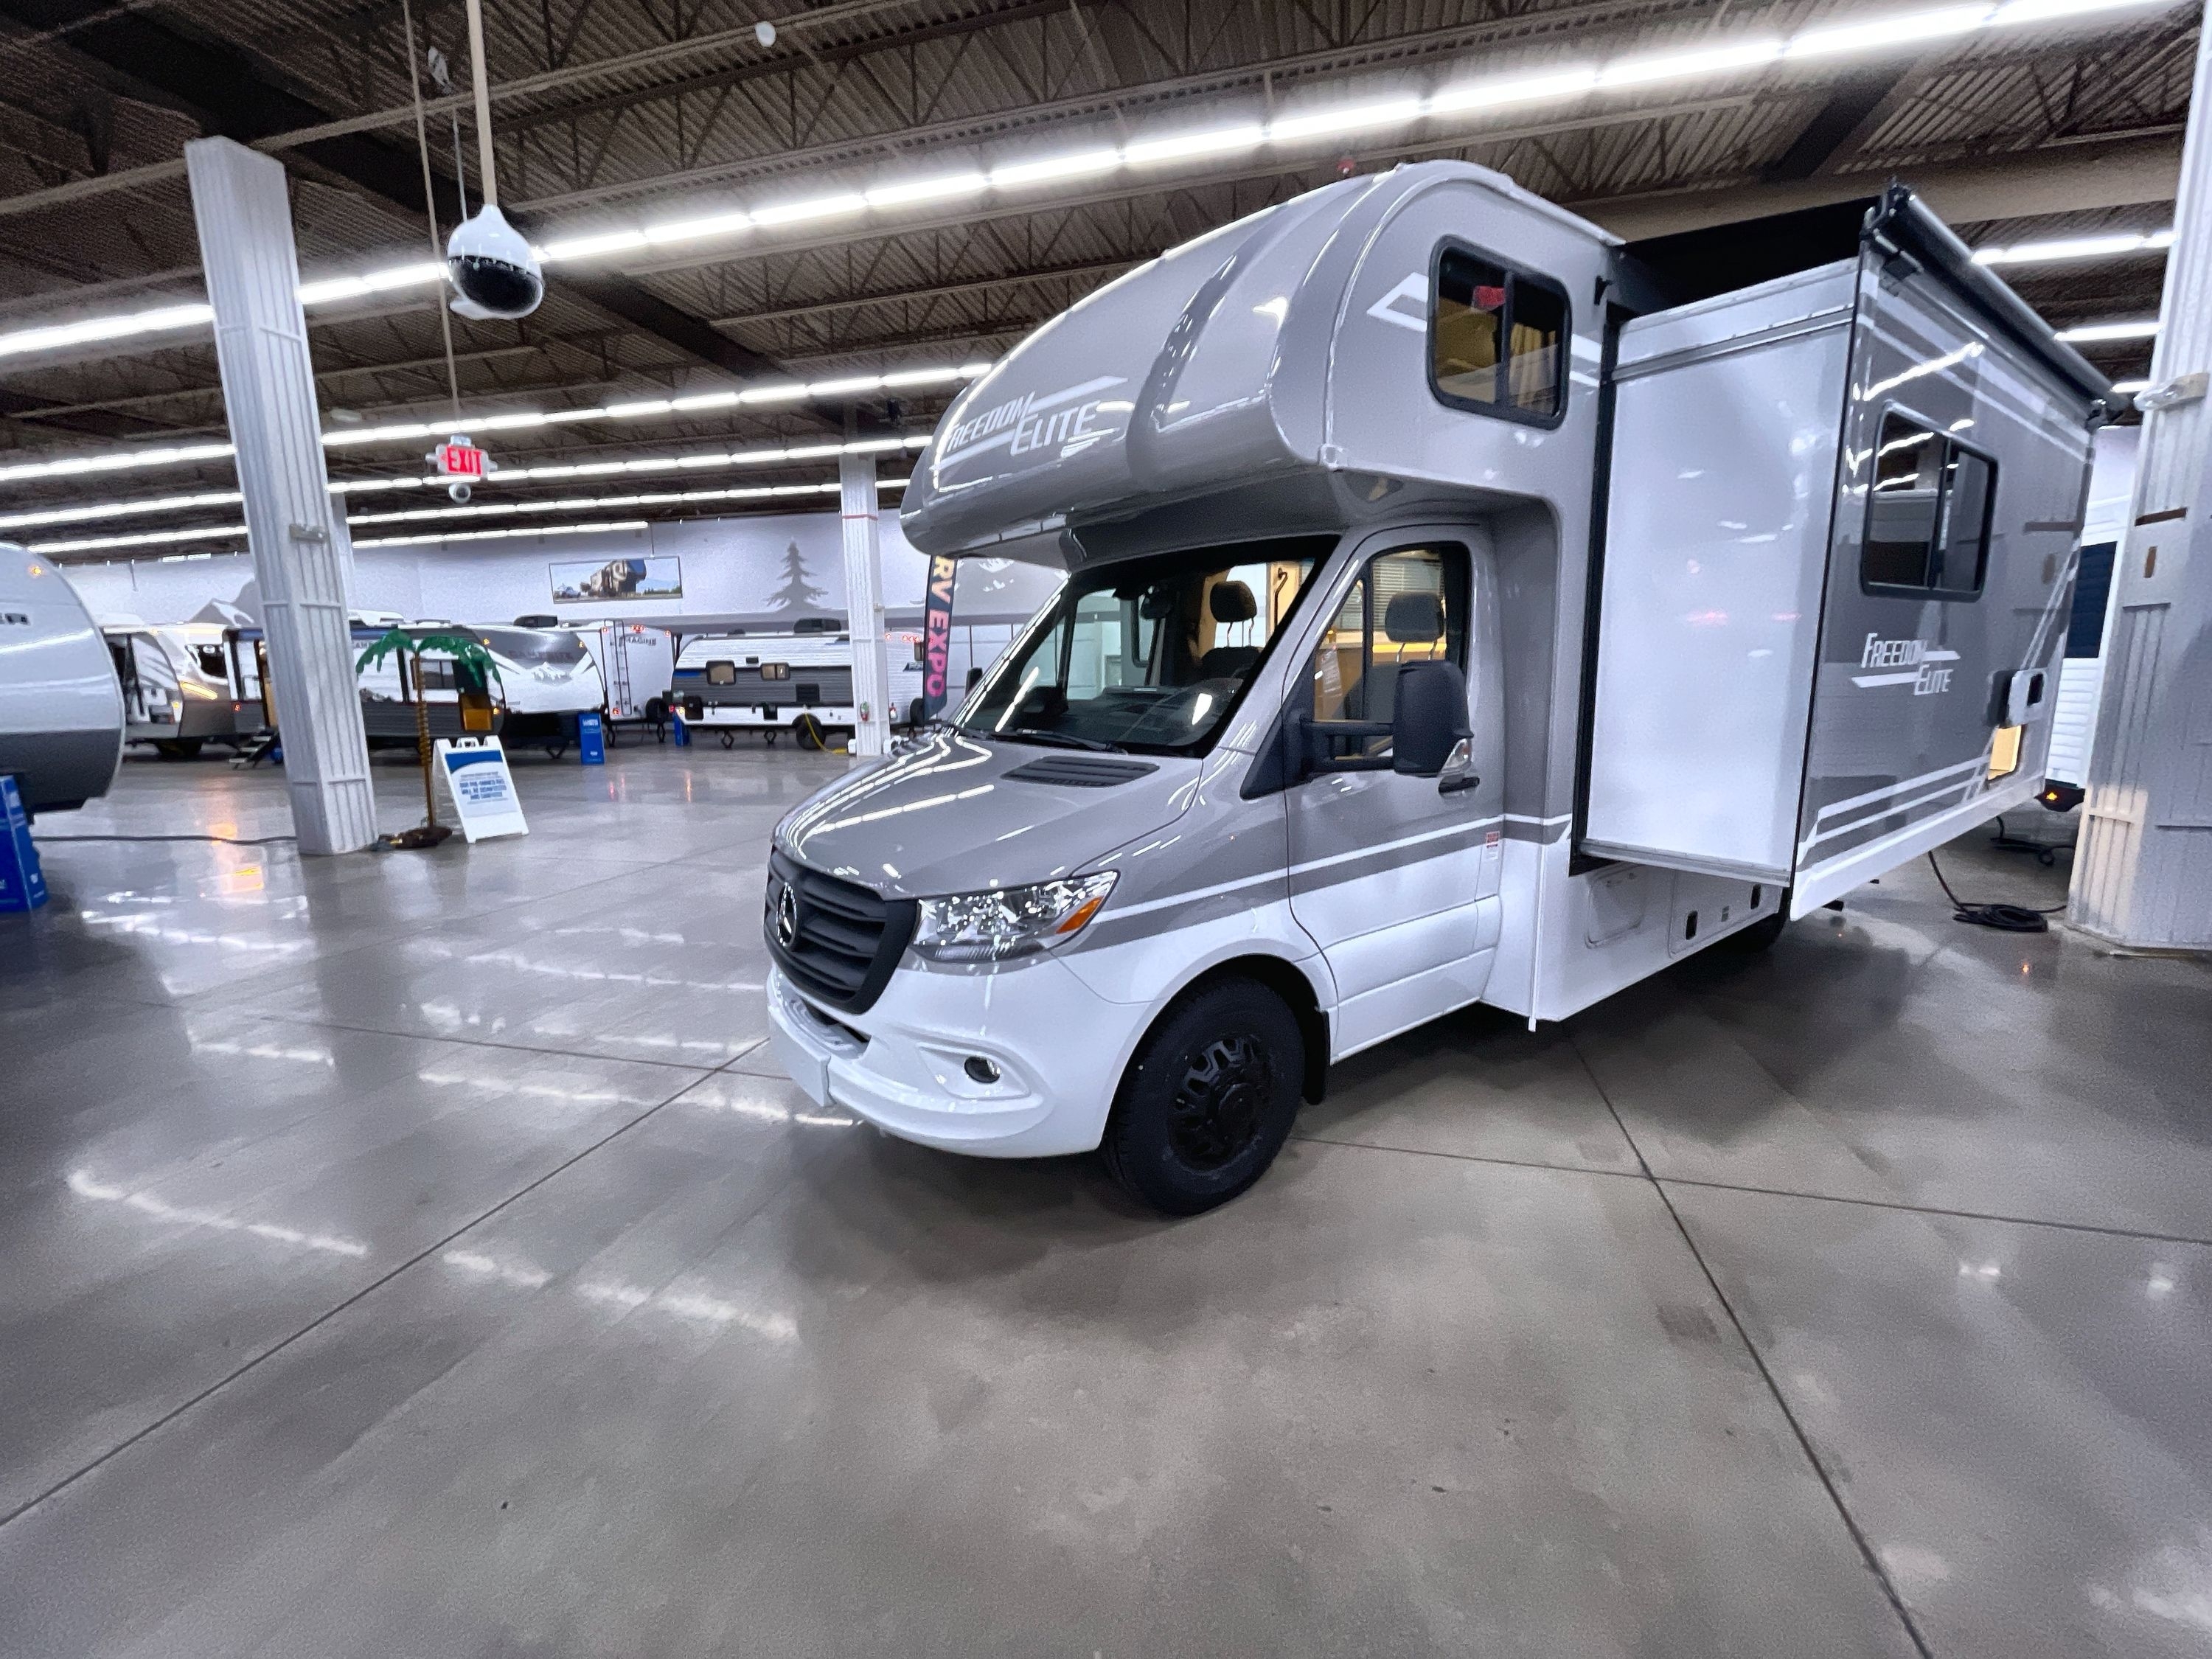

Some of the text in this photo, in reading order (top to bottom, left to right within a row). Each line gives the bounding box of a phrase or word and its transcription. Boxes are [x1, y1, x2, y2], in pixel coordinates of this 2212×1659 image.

[1010, 400, 1101, 456] ELITE
[446, 446, 482, 476] EXIT
[926, 556, 956, 698] RV EXPO
[1861, 633, 1929, 668] FREEDOM
[1914, 664, 1954, 695] ELITE
